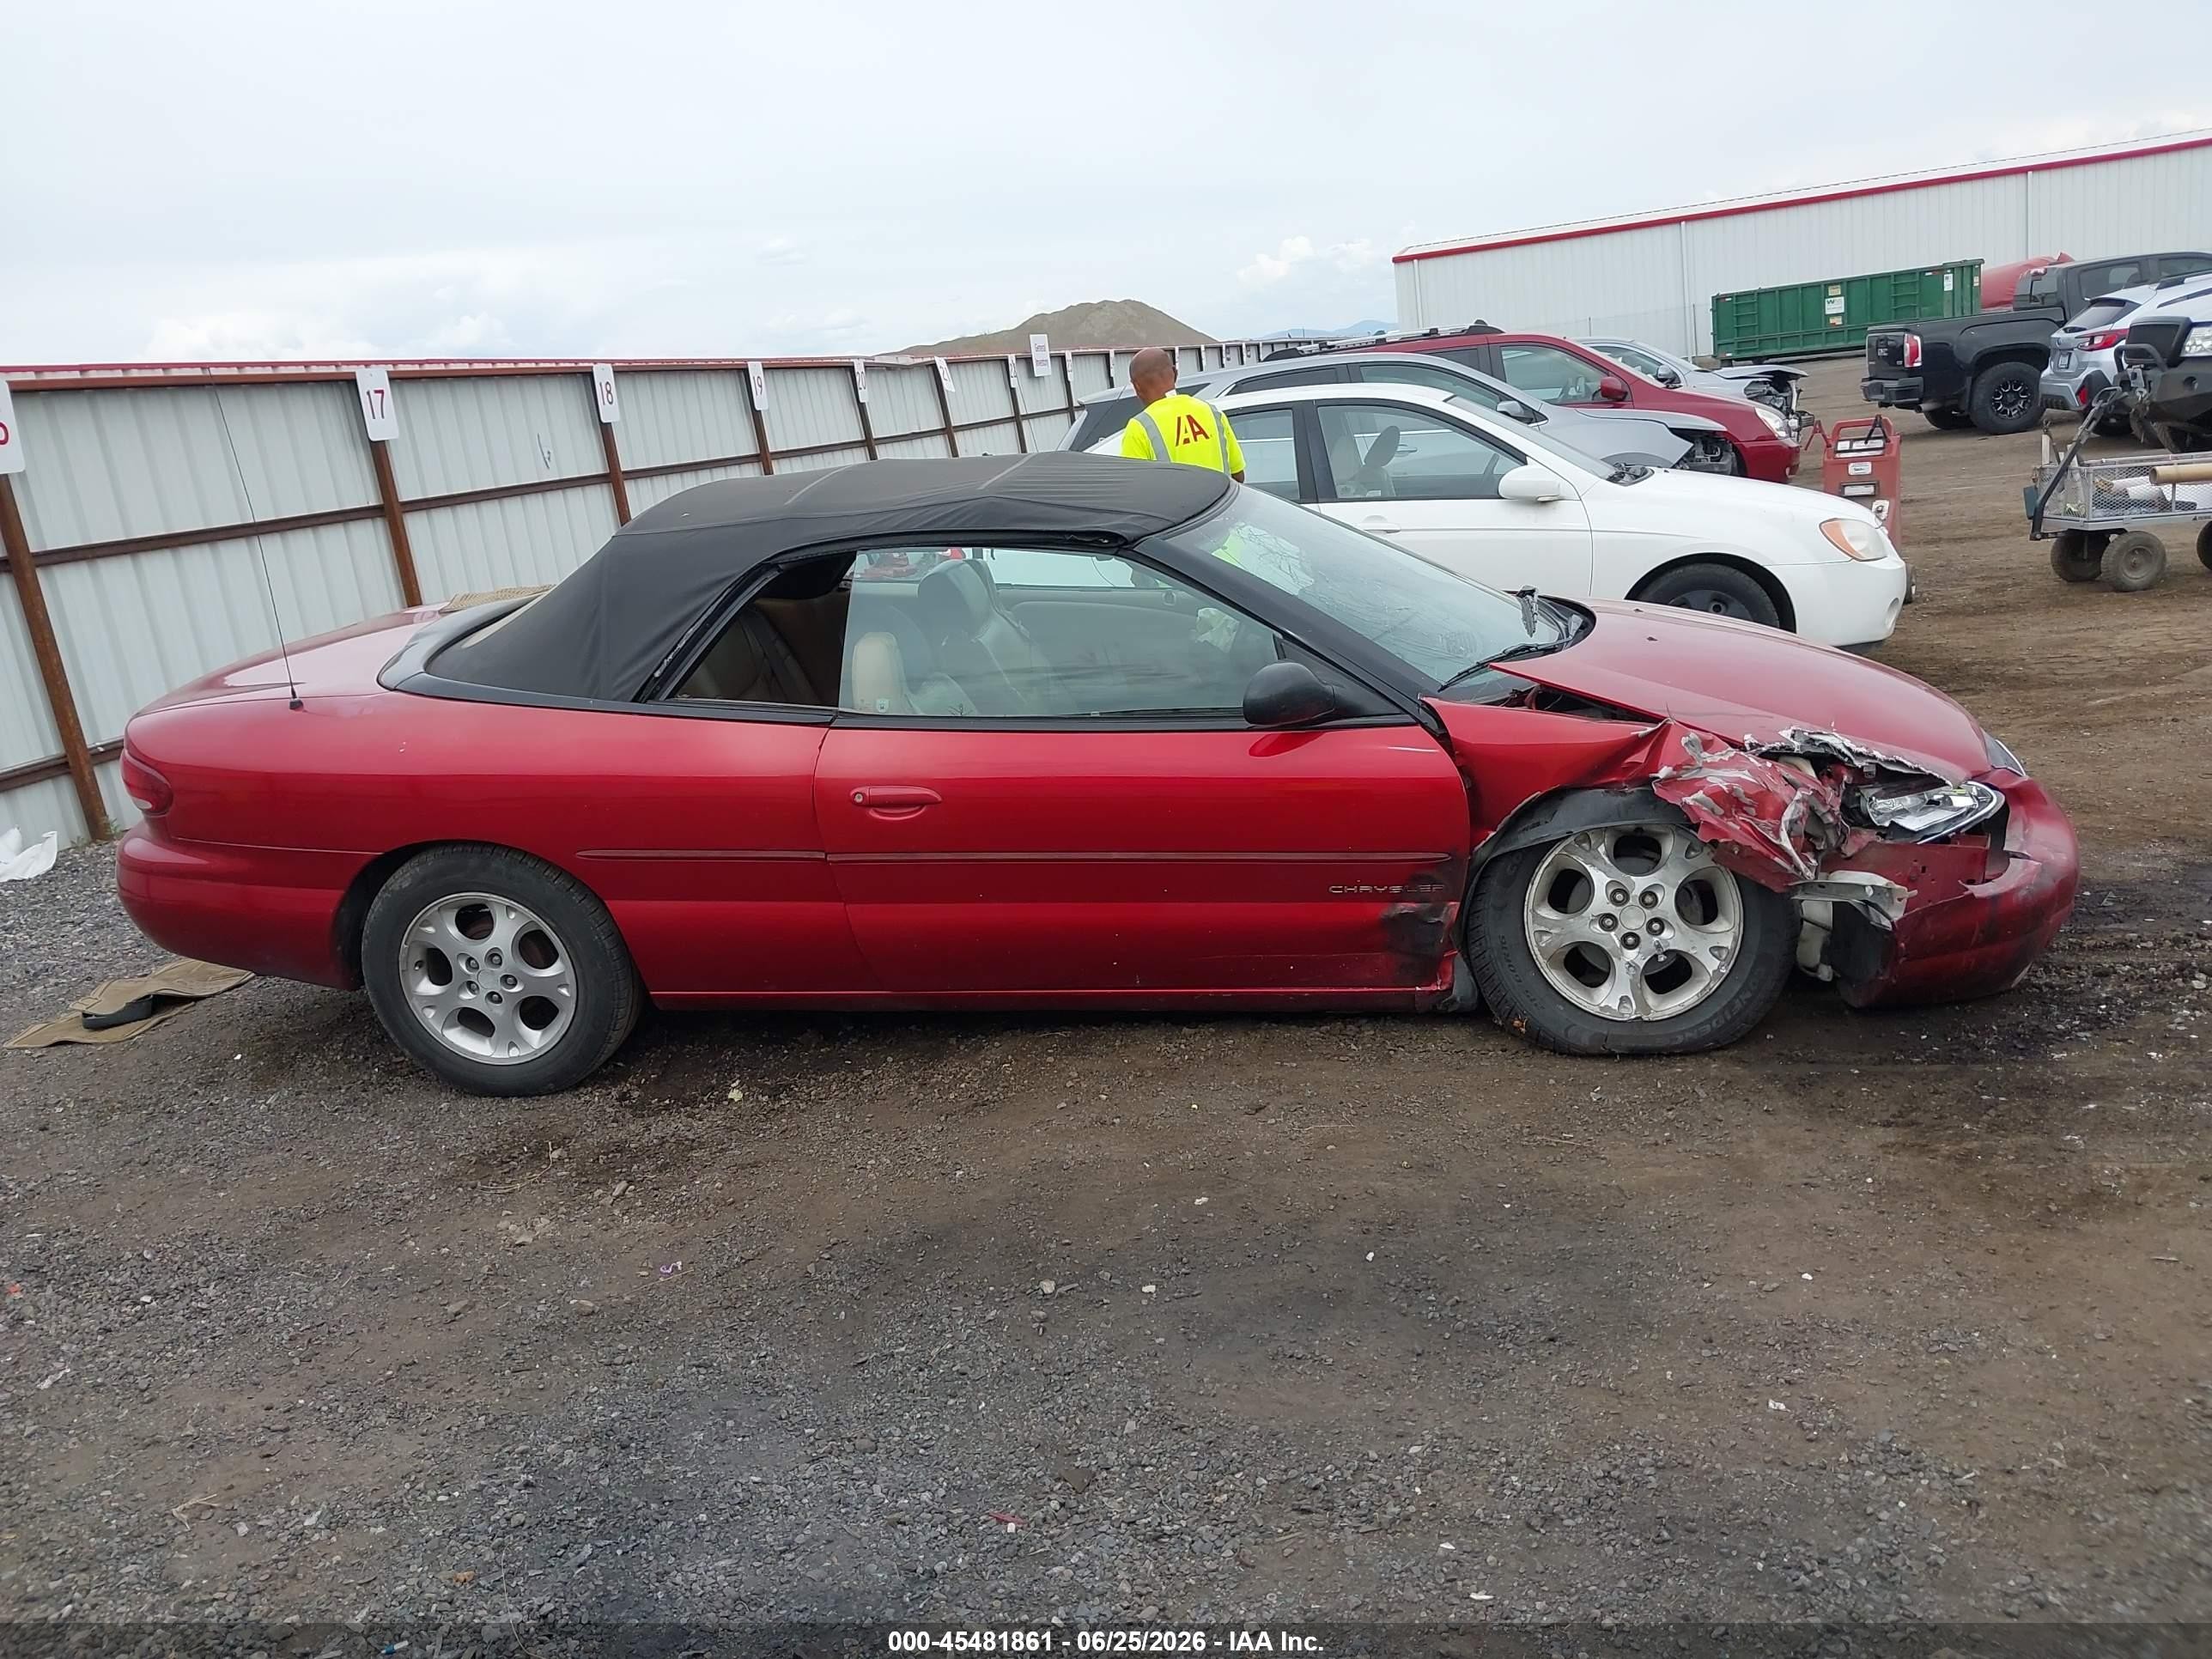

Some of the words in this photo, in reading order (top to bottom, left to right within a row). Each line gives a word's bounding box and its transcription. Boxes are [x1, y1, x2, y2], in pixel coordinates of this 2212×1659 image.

[752, 375, 763, 397] 19
[856, 371, 866, 390] 20
[366, 389, 385, 420] 17
[599, 380, 614, 406] 18
